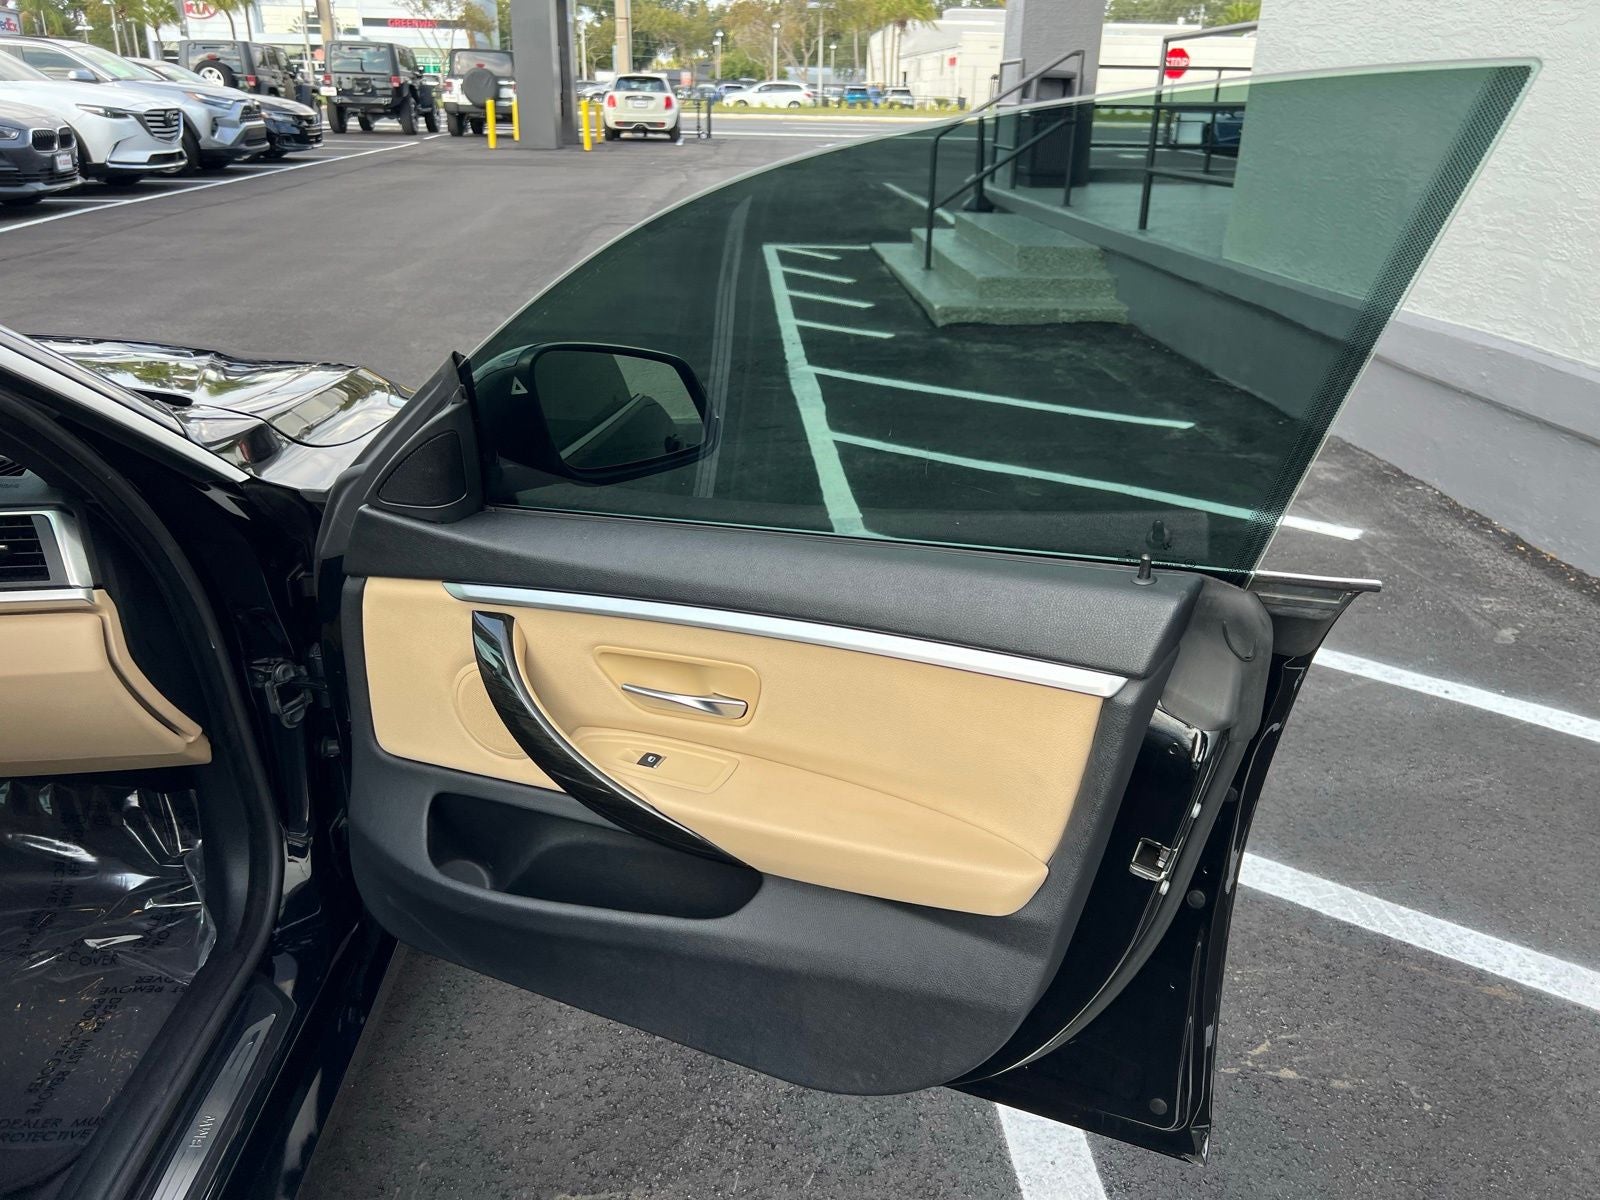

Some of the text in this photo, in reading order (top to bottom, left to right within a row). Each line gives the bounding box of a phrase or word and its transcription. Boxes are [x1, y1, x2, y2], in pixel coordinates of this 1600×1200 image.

[1166, 57, 1189, 67] STOP
[0, 1129, 94, 1143] ROTECTIVE
[189, 1115, 215, 1148] BMW
